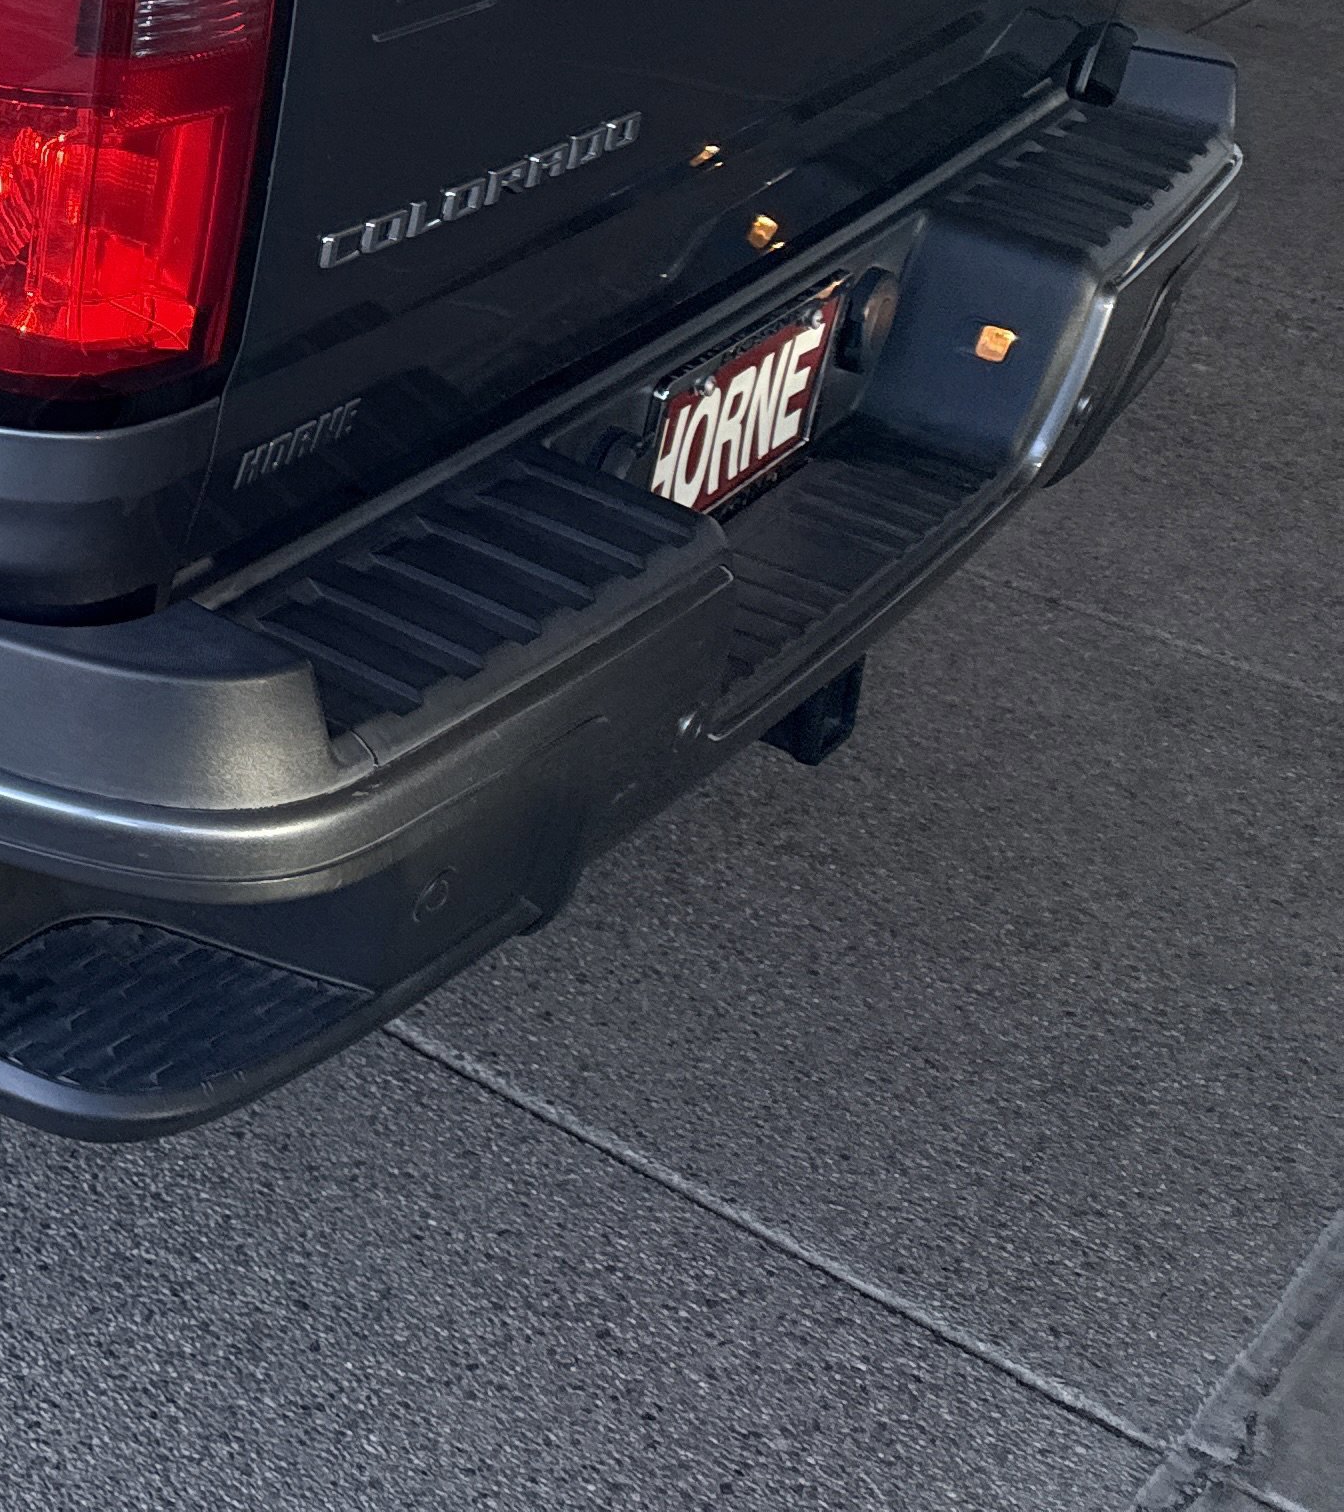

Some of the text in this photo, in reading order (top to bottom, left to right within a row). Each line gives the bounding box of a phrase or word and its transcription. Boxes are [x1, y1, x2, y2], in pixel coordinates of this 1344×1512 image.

[317, 111, 642, 269] COLORADO
[232, 397, 363, 490] HORNE
[650, 322, 827, 509] HORNE
